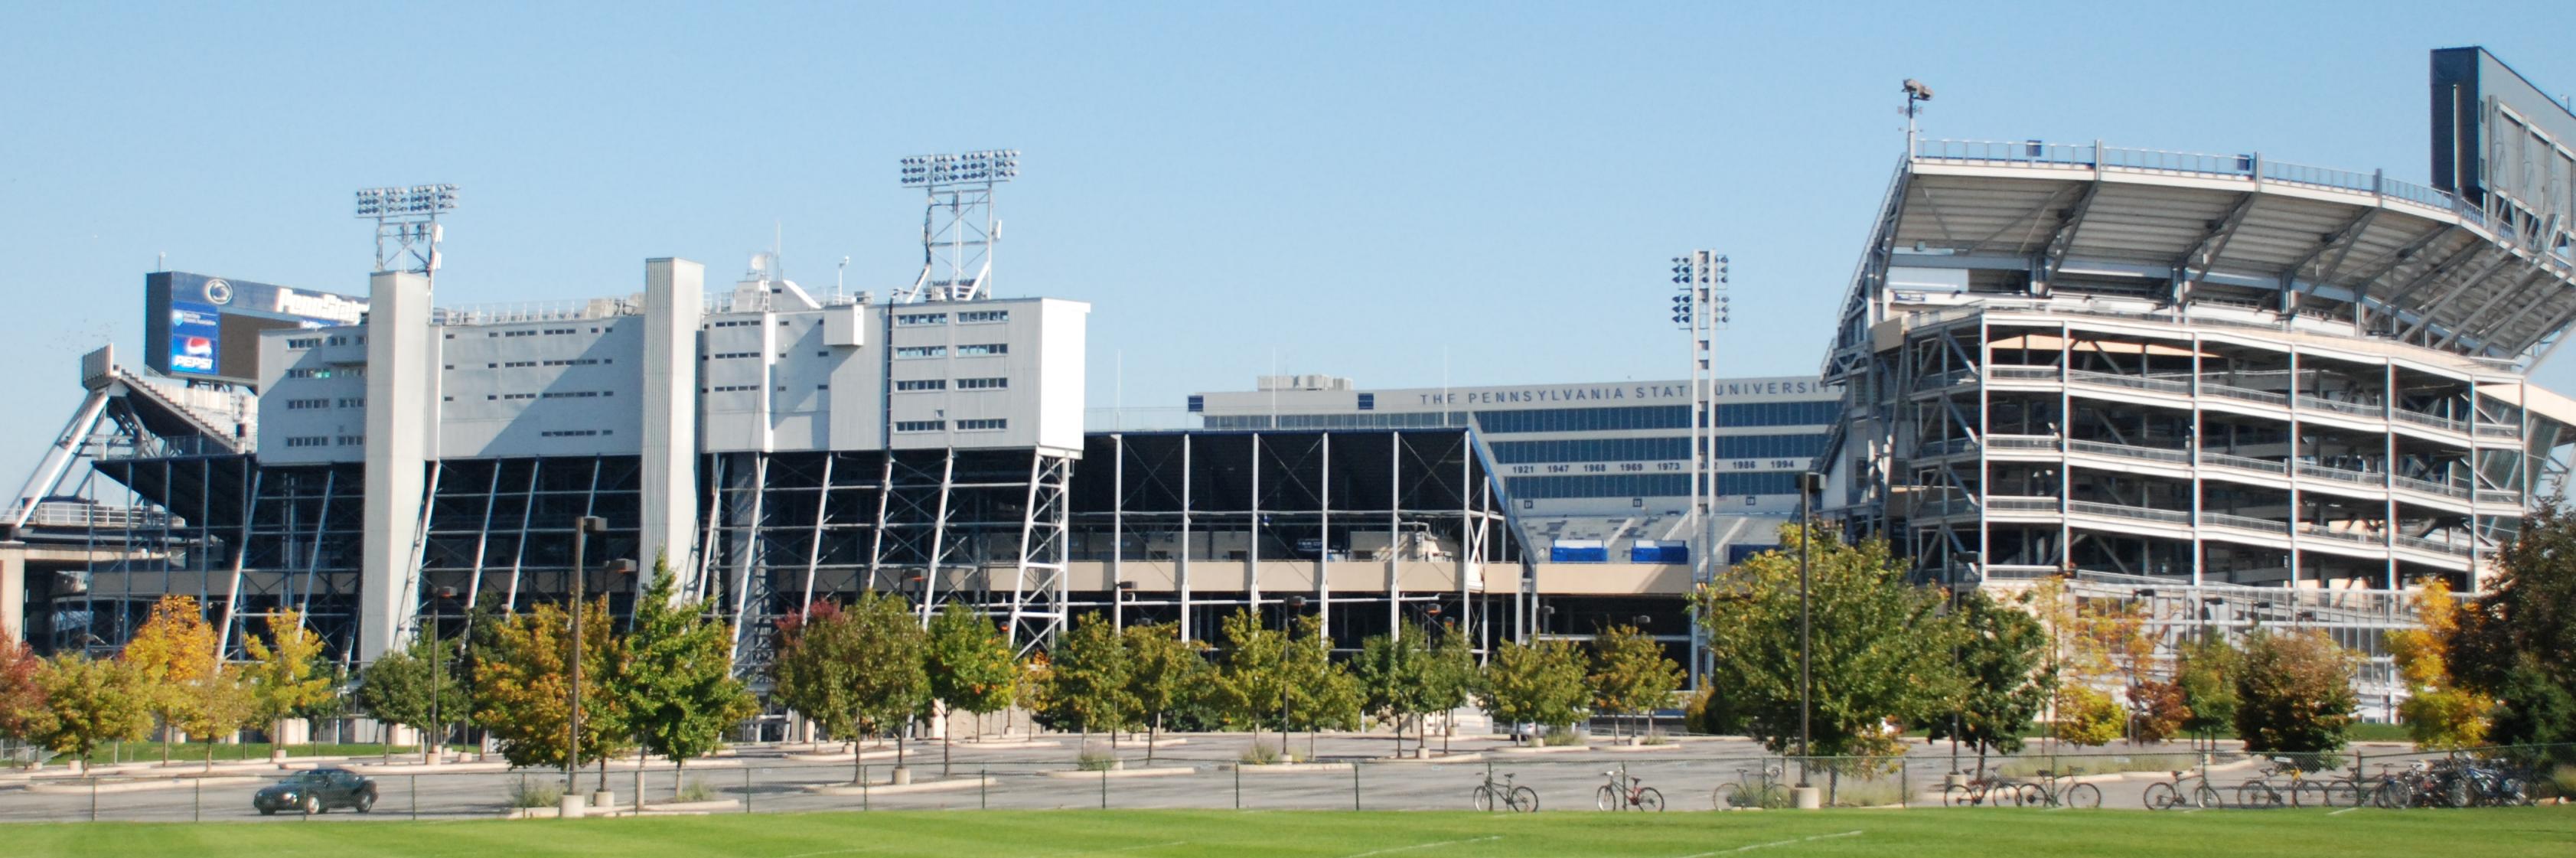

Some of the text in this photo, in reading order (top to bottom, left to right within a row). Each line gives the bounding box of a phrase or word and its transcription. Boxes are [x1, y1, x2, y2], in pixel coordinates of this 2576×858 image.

[174, 354, 214, 370] PEPSI
[1468, 387, 1624, 404] PENNSYLVANIA
[1635, 384, 1693, 399] STAT
[1512, 459, 1795, 474] 1921 1947 1968 1969 1973 1986 1994
